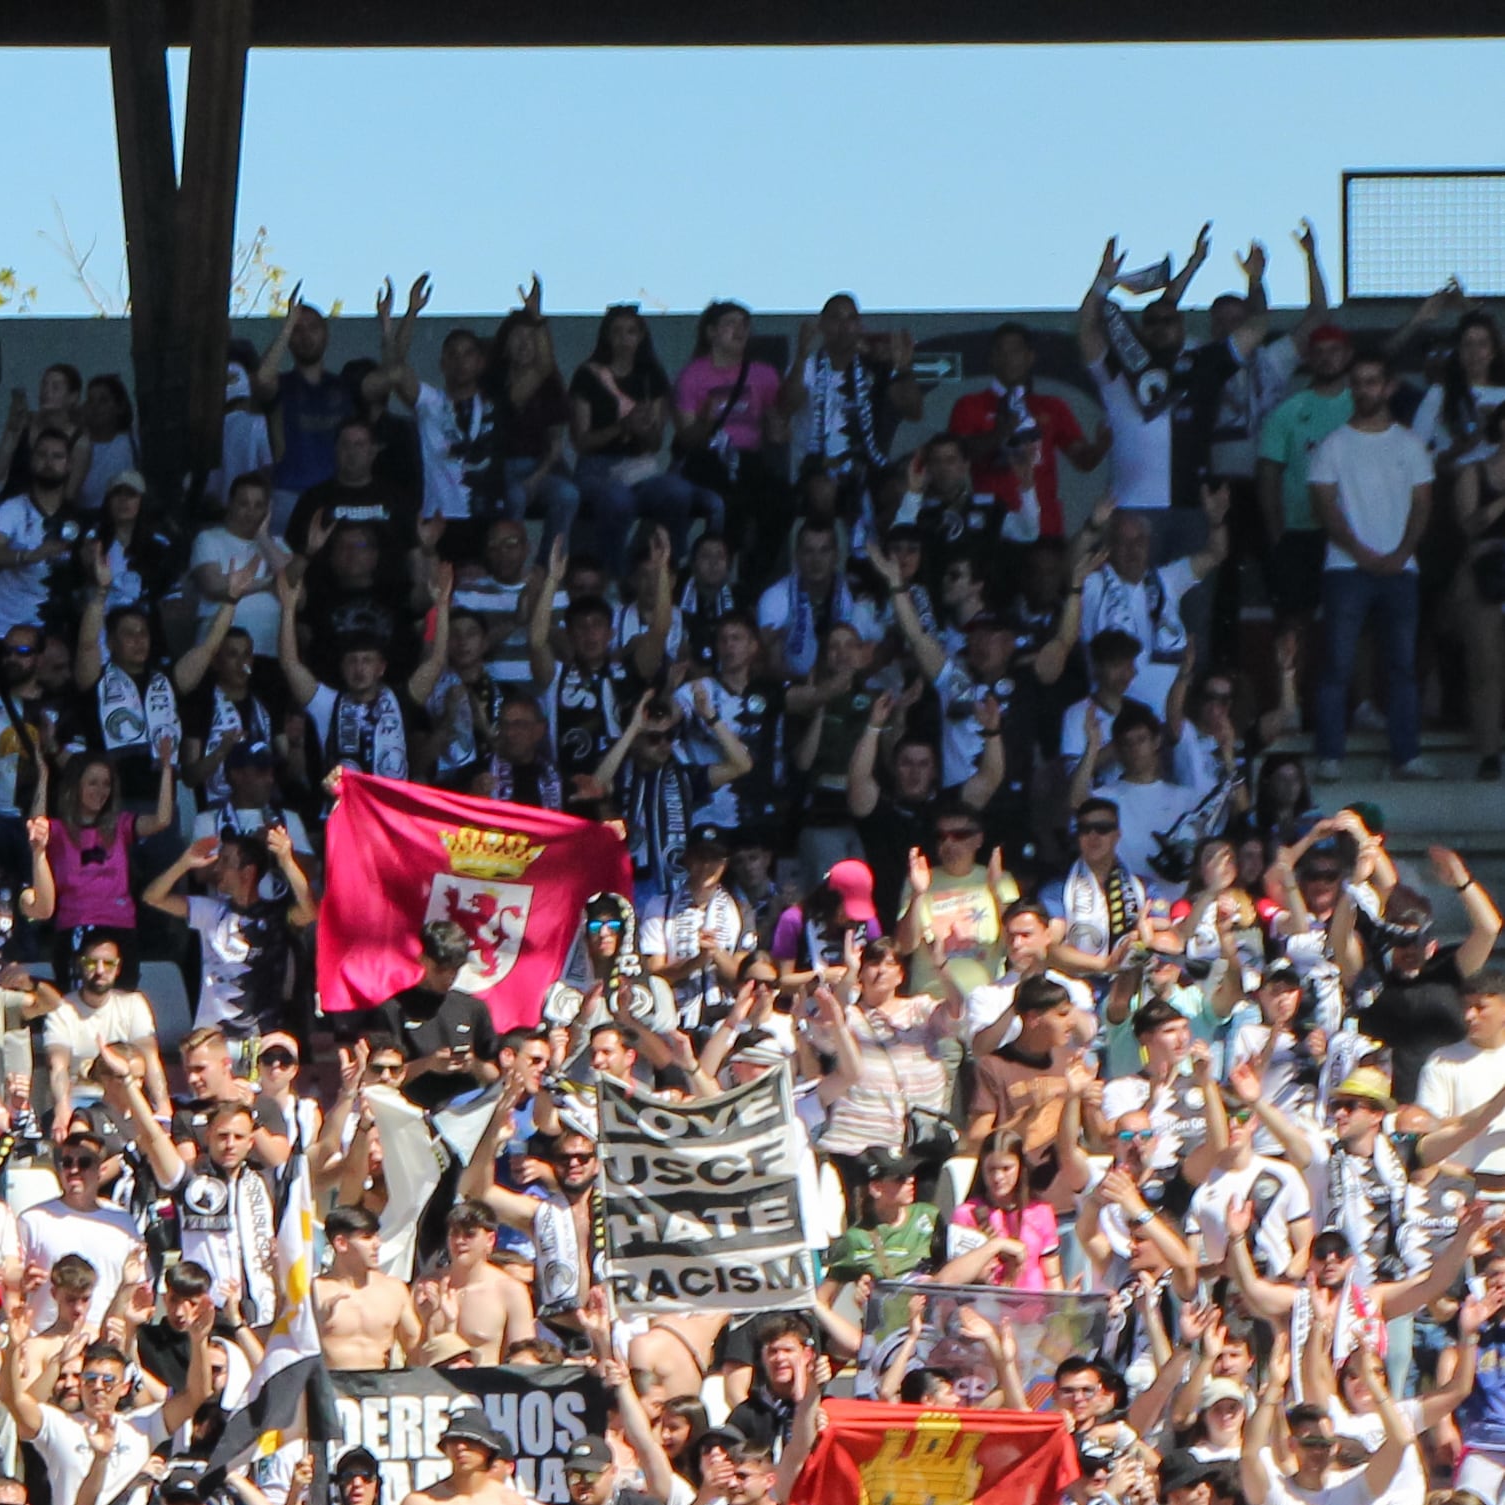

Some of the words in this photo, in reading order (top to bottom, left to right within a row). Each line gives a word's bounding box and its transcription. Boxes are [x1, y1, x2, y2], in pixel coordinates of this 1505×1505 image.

[602, 1086, 781, 1141] LOVE
[604, 1138, 787, 1186] USCF
[609, 1196, 794, 1249] HATE
[612, 1256, 810, 1301] RACISM
[335, 1391, 587, 1461] DEREHOS
